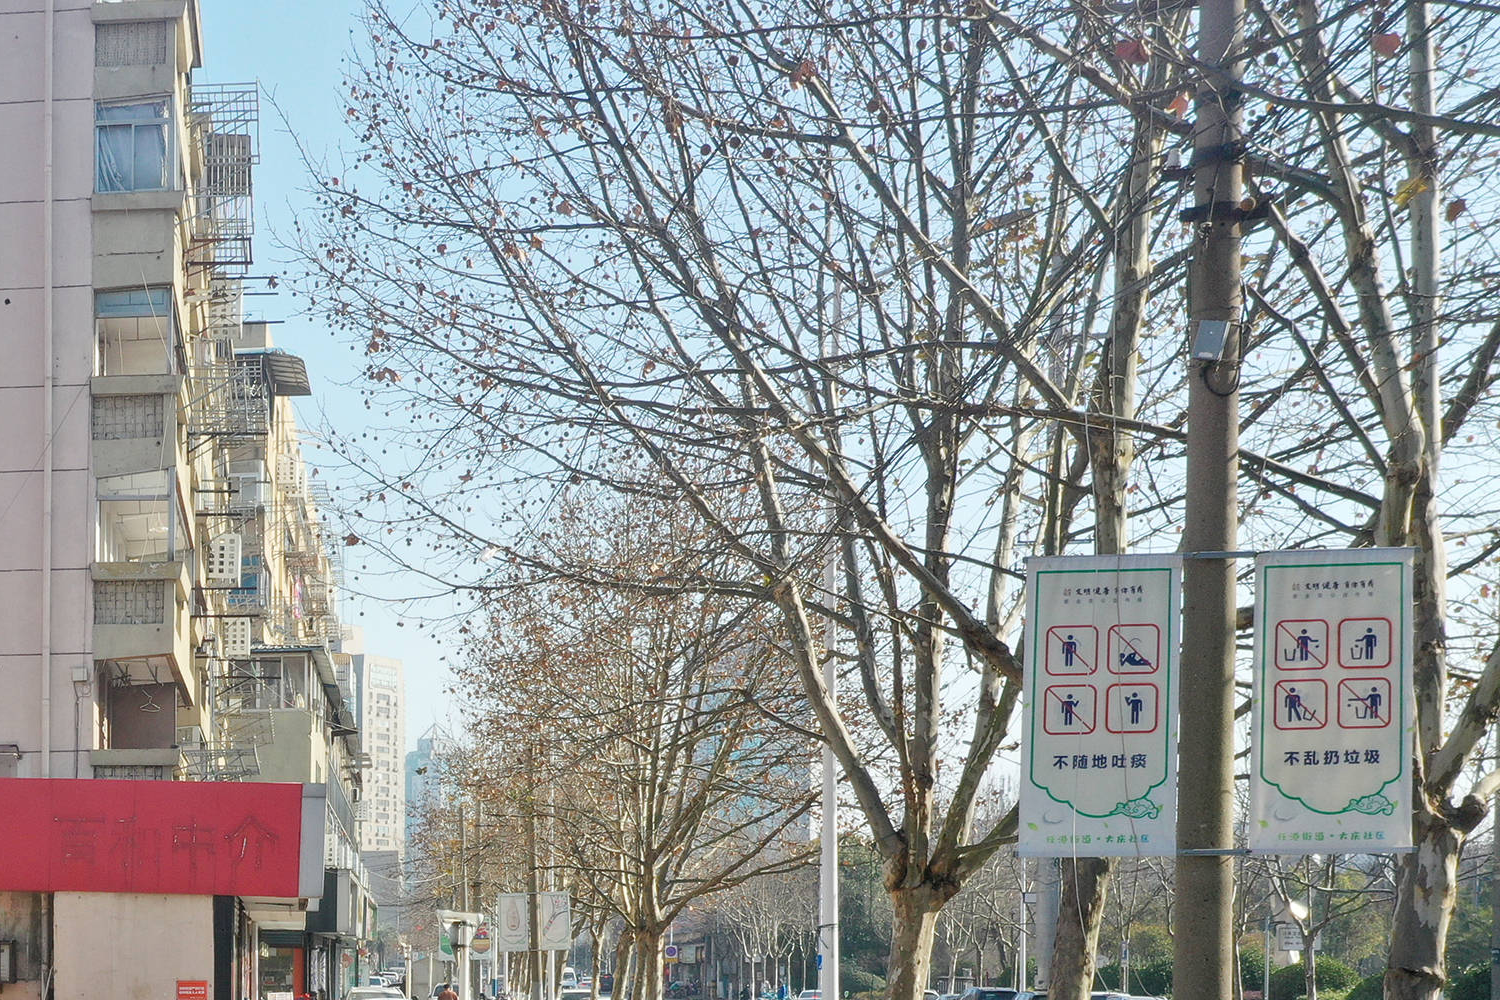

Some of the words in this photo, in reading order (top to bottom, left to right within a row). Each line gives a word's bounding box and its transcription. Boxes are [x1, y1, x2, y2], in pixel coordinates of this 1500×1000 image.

[1053, 753, 1148, 770] 不随地吐痰
[1284, 749, 1380, 766] 不乱扔垃圾
